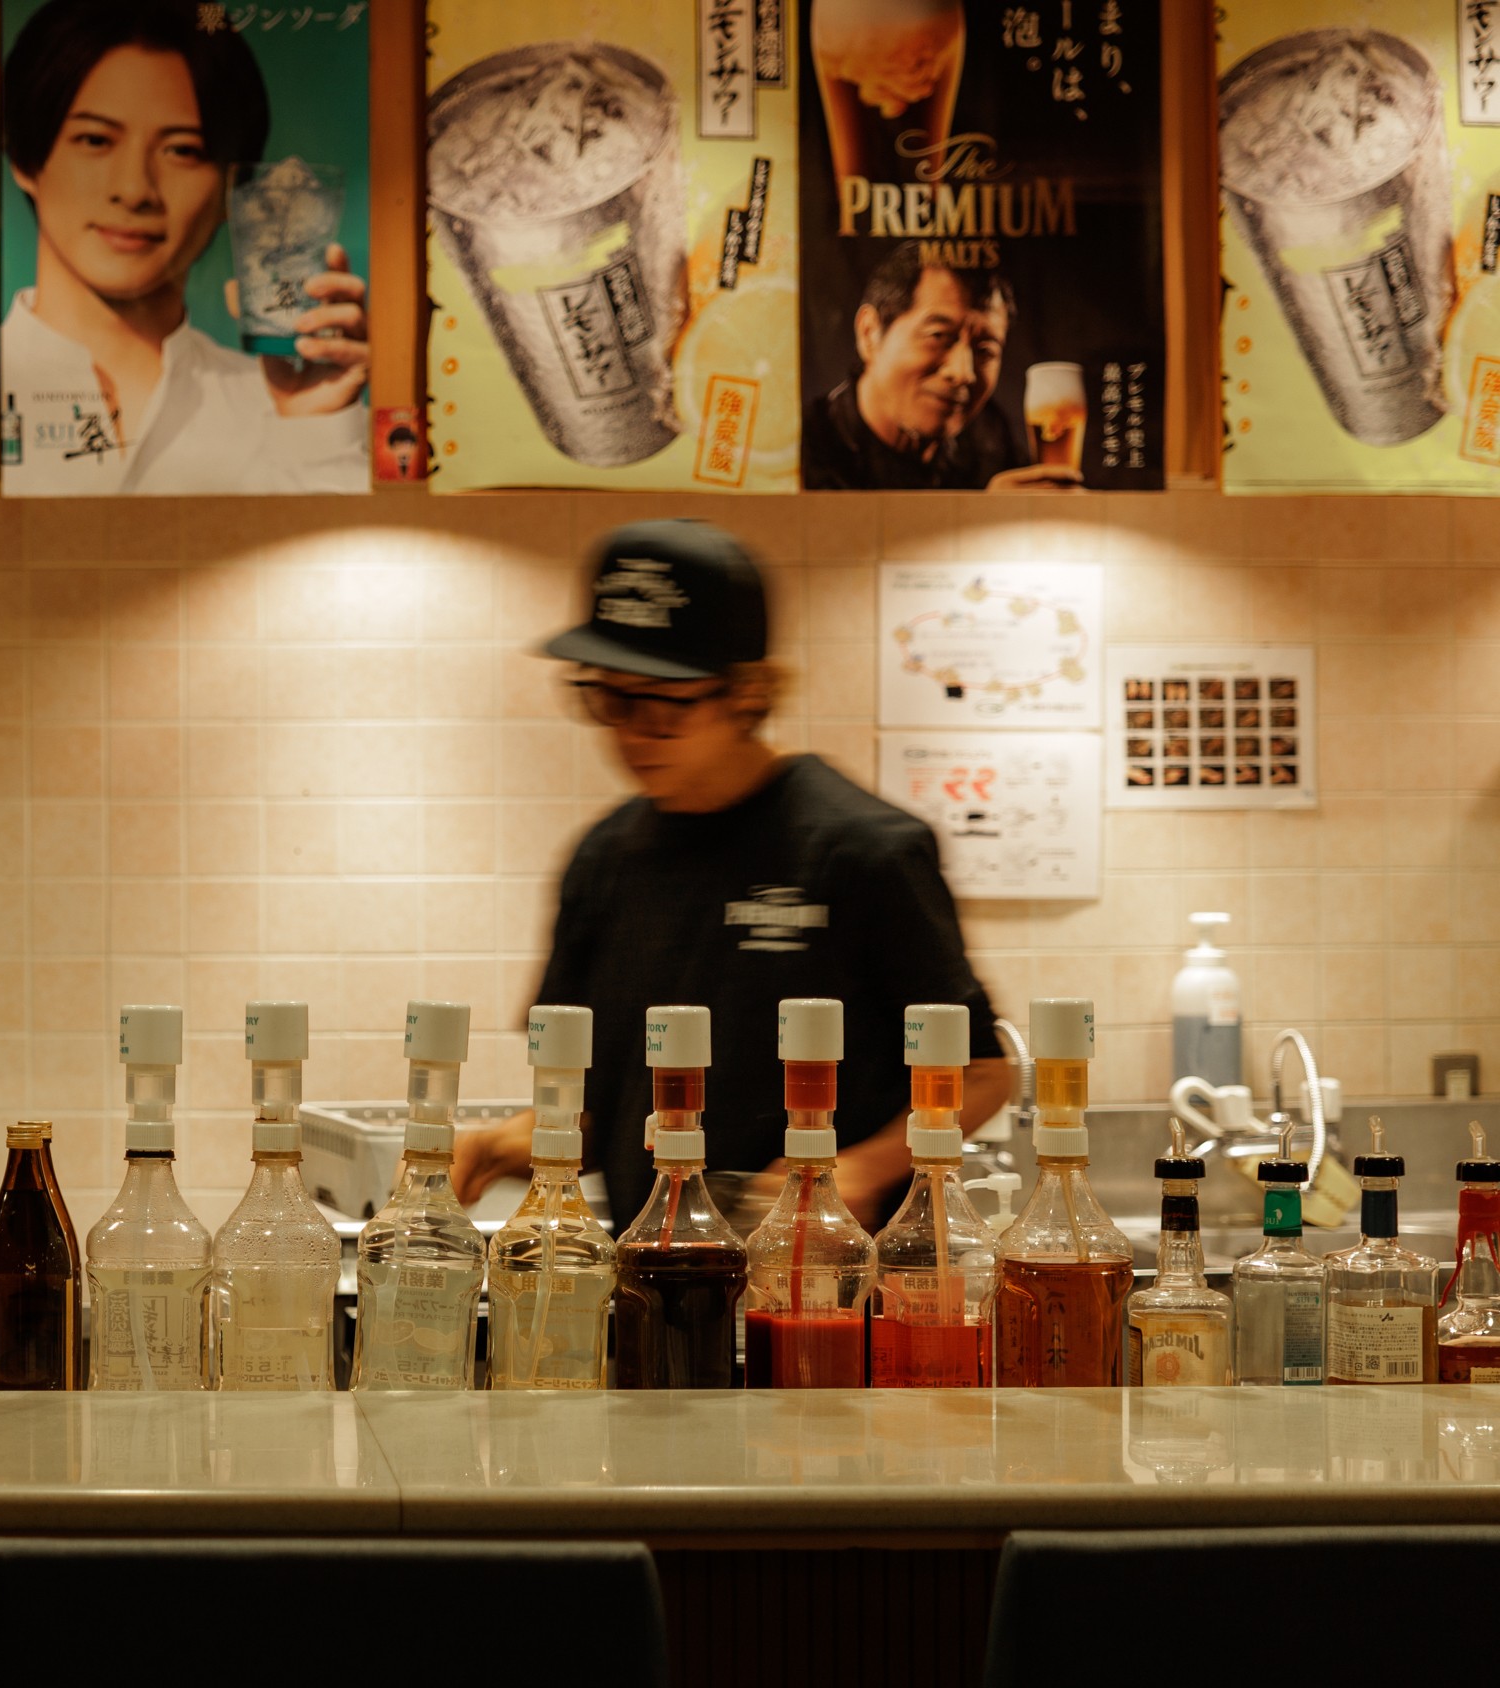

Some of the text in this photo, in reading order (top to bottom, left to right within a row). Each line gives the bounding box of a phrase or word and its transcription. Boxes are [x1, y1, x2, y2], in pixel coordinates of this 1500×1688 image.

[894, 129, 1015, 182] The
[837, 174, 1077, 238] PREMIUM
[918, 238, 1000, 269] MALT'S
